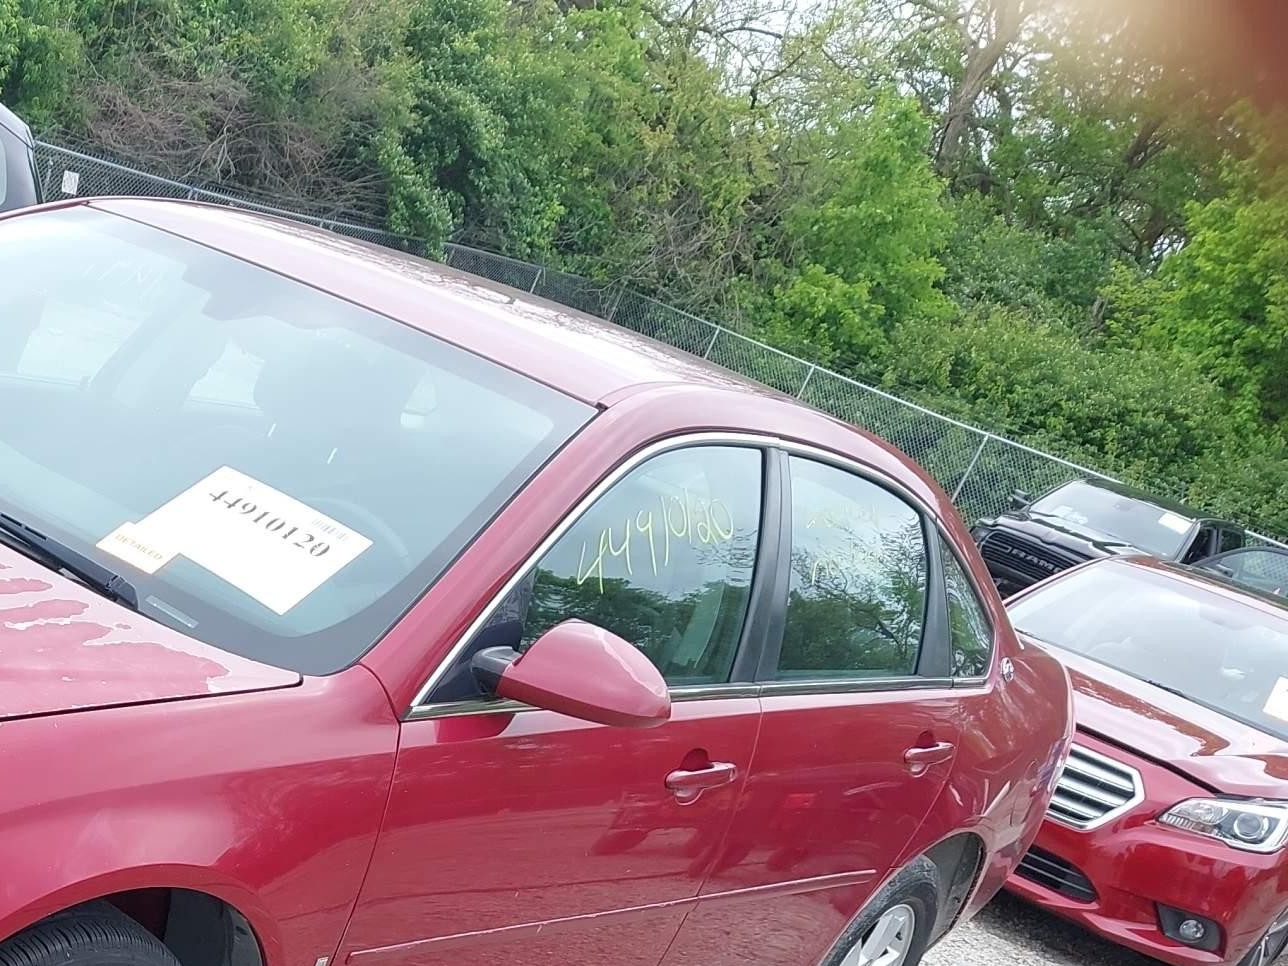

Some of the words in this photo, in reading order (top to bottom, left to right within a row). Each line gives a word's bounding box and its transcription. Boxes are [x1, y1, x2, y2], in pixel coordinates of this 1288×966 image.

[209, 491, 330, 556] 44910120
[577, 488, 733, 594] 44910120
[1012, 549, 1054, 570] RAM
